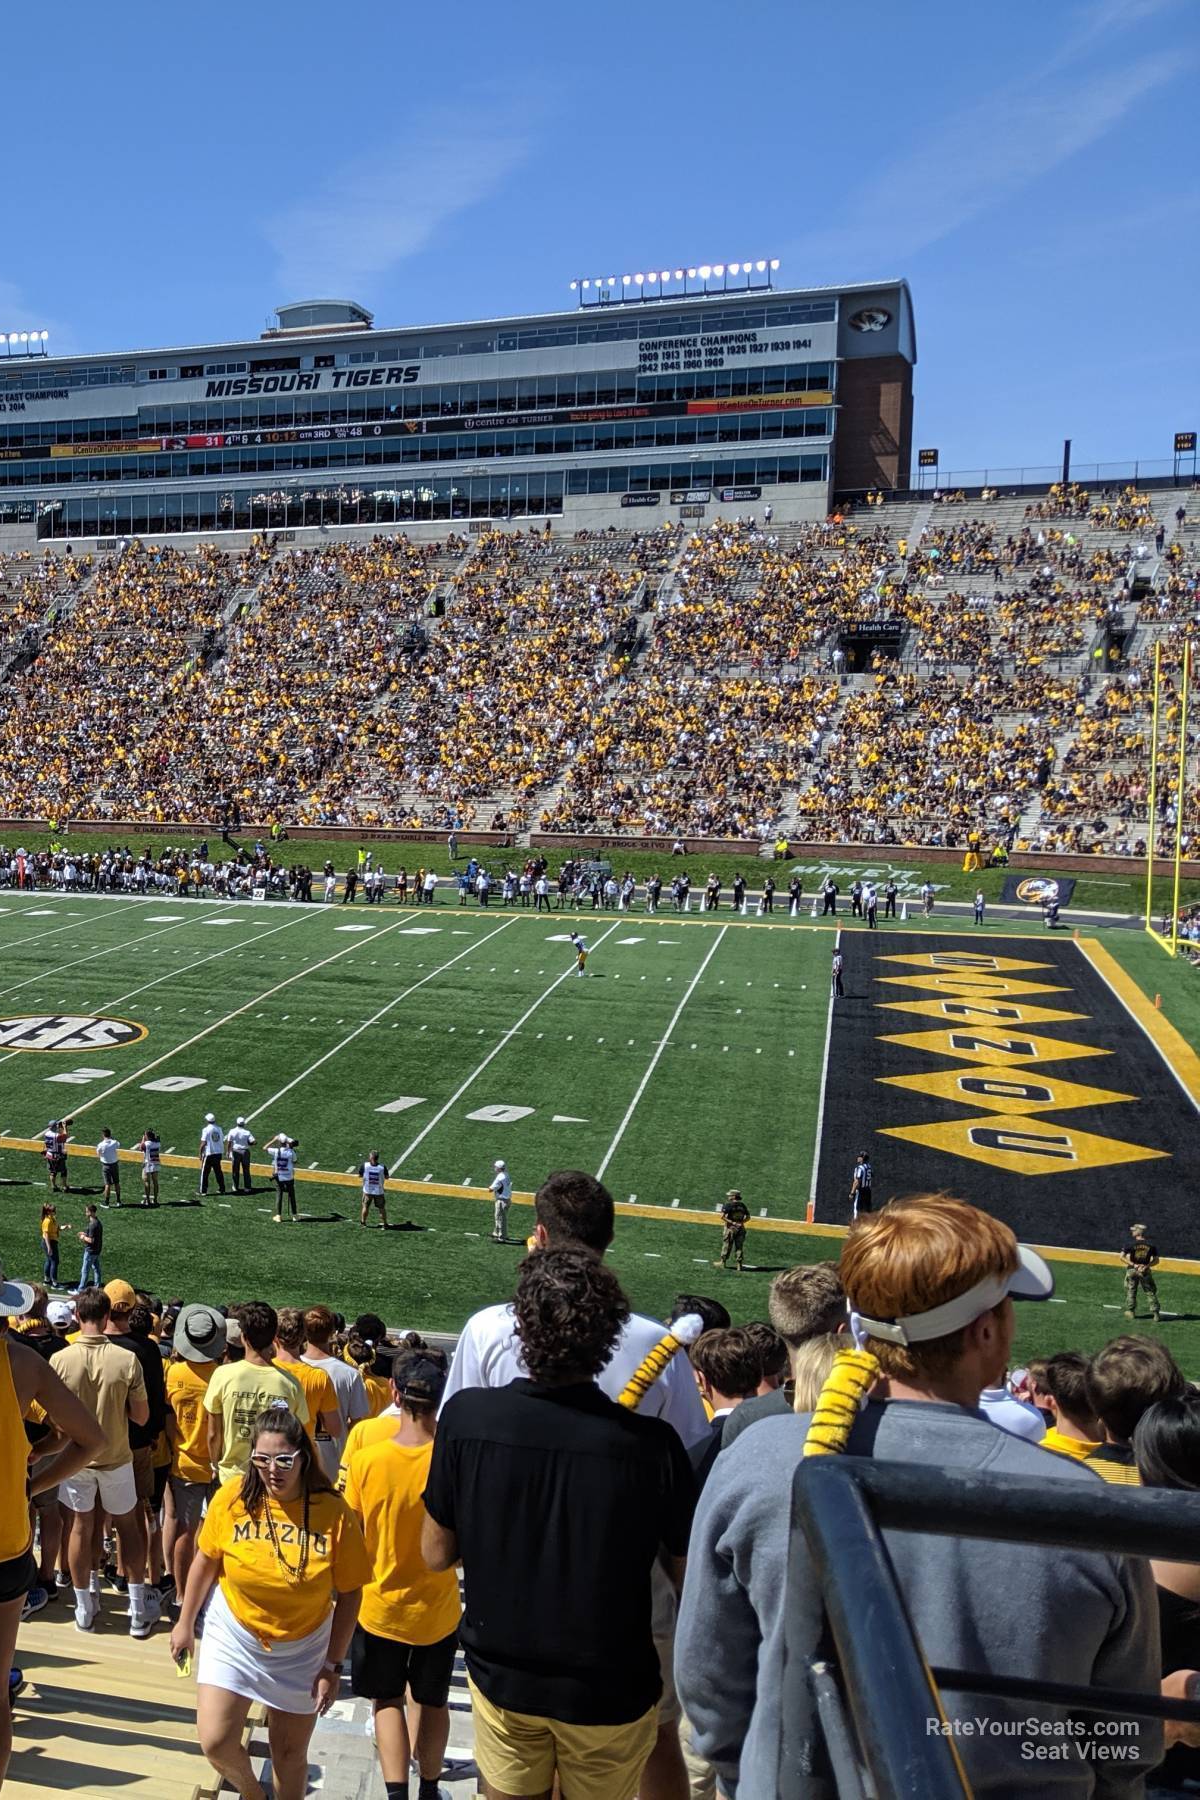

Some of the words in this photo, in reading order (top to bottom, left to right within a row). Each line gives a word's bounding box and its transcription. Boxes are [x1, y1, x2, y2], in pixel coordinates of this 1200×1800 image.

[639, 338, 698, 351] CONFERENCE
[700, 332, 757, 346] CHAMPIONS
[662, 350, 680, 361] 1913
[684, 349, 701, 359] 1919
[704, 347, 724, 358] 1924
[749, 343, 769, 354] 1927
[771, 341, 791, 352] 1939
[792, 339, 812, 349] 1941
[638, 363, 658, 373] 1942
[660, 362, 680, 372] 1945
[704, 358, 725, 368] 1969
[205, 372, 321, 398] MISSOURI
[331, 365, 421, 388] TIGERS
[5, 392, 24, 402] EAST
[25, 389, 69, 401] CHAMPIONS
[8, 402, 25, 412] 2014
[507, 417, 519, 425] ON
[521, 415, 553, 424] TURNER
[206, 436, 219, 447] 31
[254, 434, 262, 443] 4
[265, 431, 298, 443] 10:12
[313, 429, 331, 439] 3RD
[350, 426, 363, 437] 48
[374, 425, 382, 436] 0
[858, 623, 883, 632] Health
[884, 622, 900, 632] Care
[232, 1391, 257, 1400] FLEET
